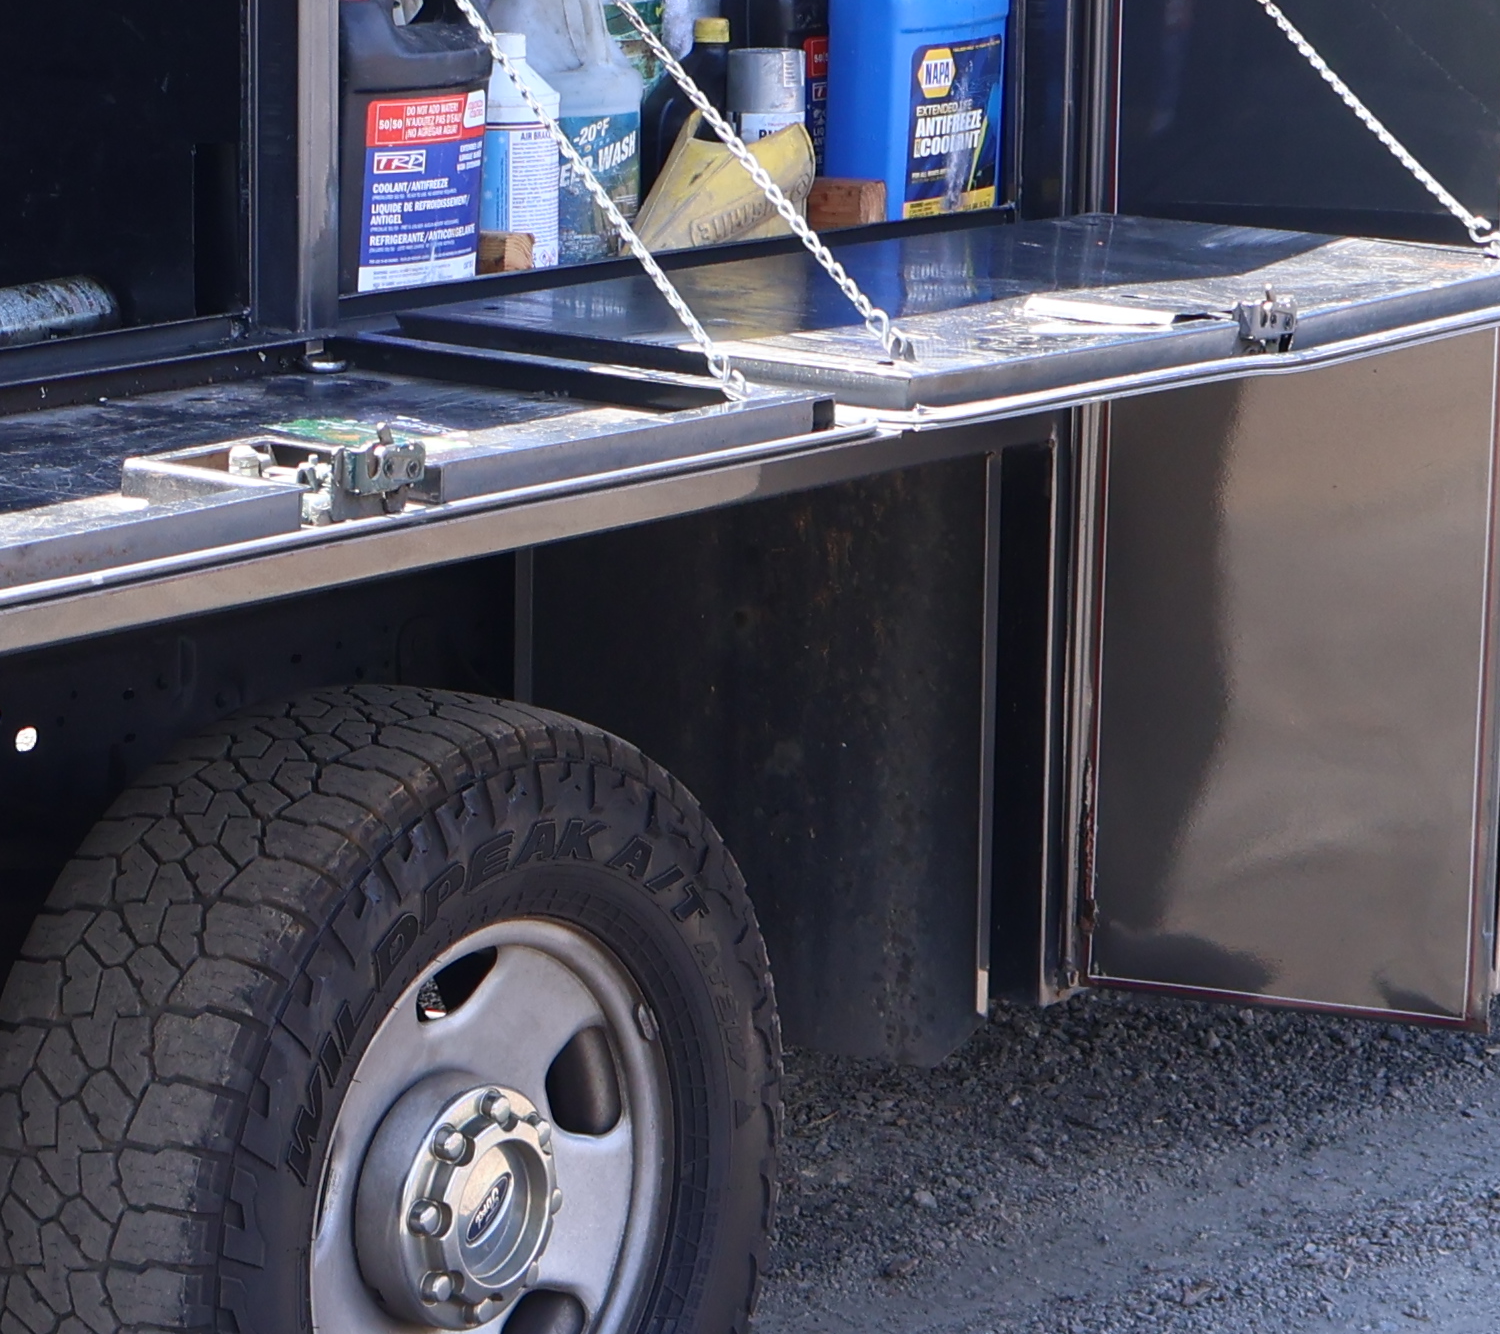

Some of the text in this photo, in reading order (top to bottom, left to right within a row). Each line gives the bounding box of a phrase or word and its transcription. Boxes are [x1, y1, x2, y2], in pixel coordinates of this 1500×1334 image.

[924, 59, 951, 86] NAPA
[915, 101, 958, 117] EXTENDED
[915, 109, 983, 138] ANTIFREEZE
[597, 130, 637, 173] WASH
[920, 129, 981, 158] COOLANT
[376, 154, 424, 170] TRP
[372, 177, 449, 194] COOLANT/ANTIFREEZE
[371, 203, 403, 215] LIQUIDE
[403, 202, 413, 212] DE
[370, 214, 403, 226] ANTIGEL
[288, 818, 607, 1187] WILDPEAK
[606, 835, 711, 923] A/T
